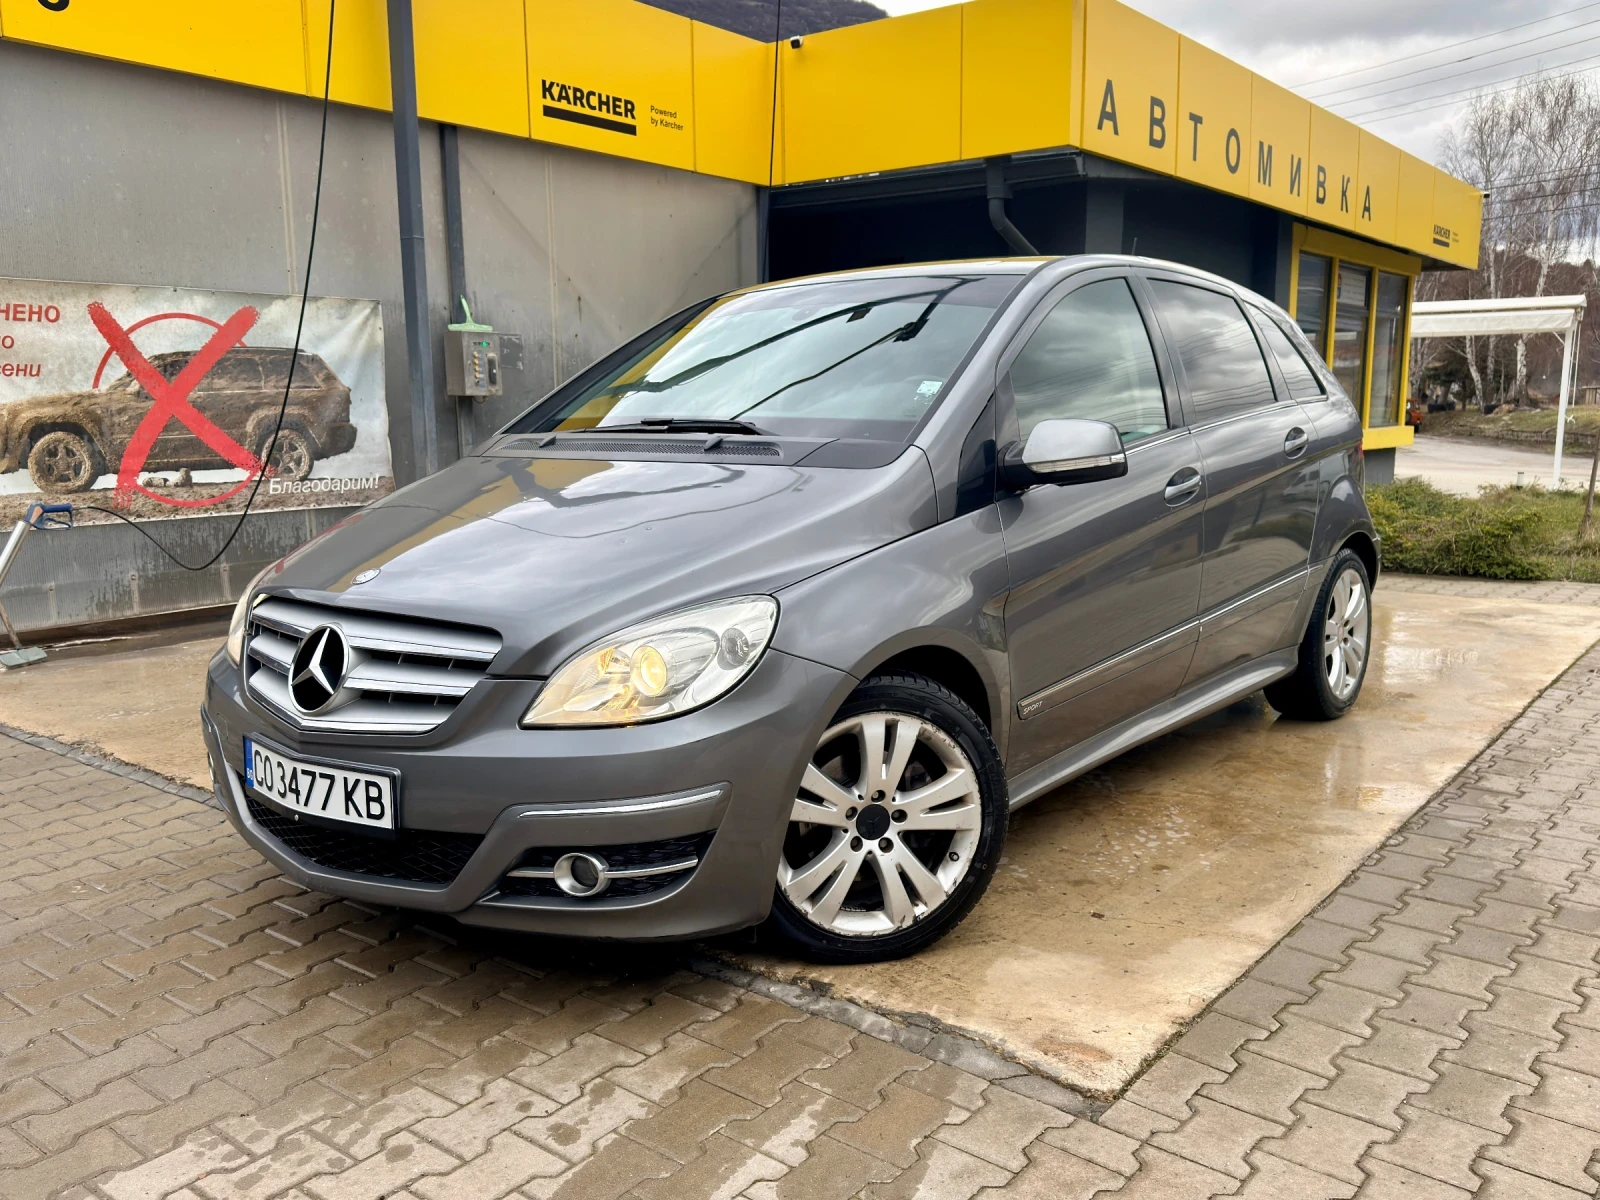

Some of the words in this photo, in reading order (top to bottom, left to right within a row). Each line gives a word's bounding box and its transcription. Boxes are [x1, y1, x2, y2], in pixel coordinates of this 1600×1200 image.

[541, 79, 637, 120] KÄRCHER
[650, 105, 678, 119] Powered
[650, 116, 659, 128] by
[1097, 78, 1372, 222] АВТОМИВКА
[0, 335, 15, 349] о
[0, 363, 41, 377] ени
[269, 473, 380, 494] Благодарим!
[1023, 700, 1044, 715] SPORT
[277, 760, 335, 811] 3477
